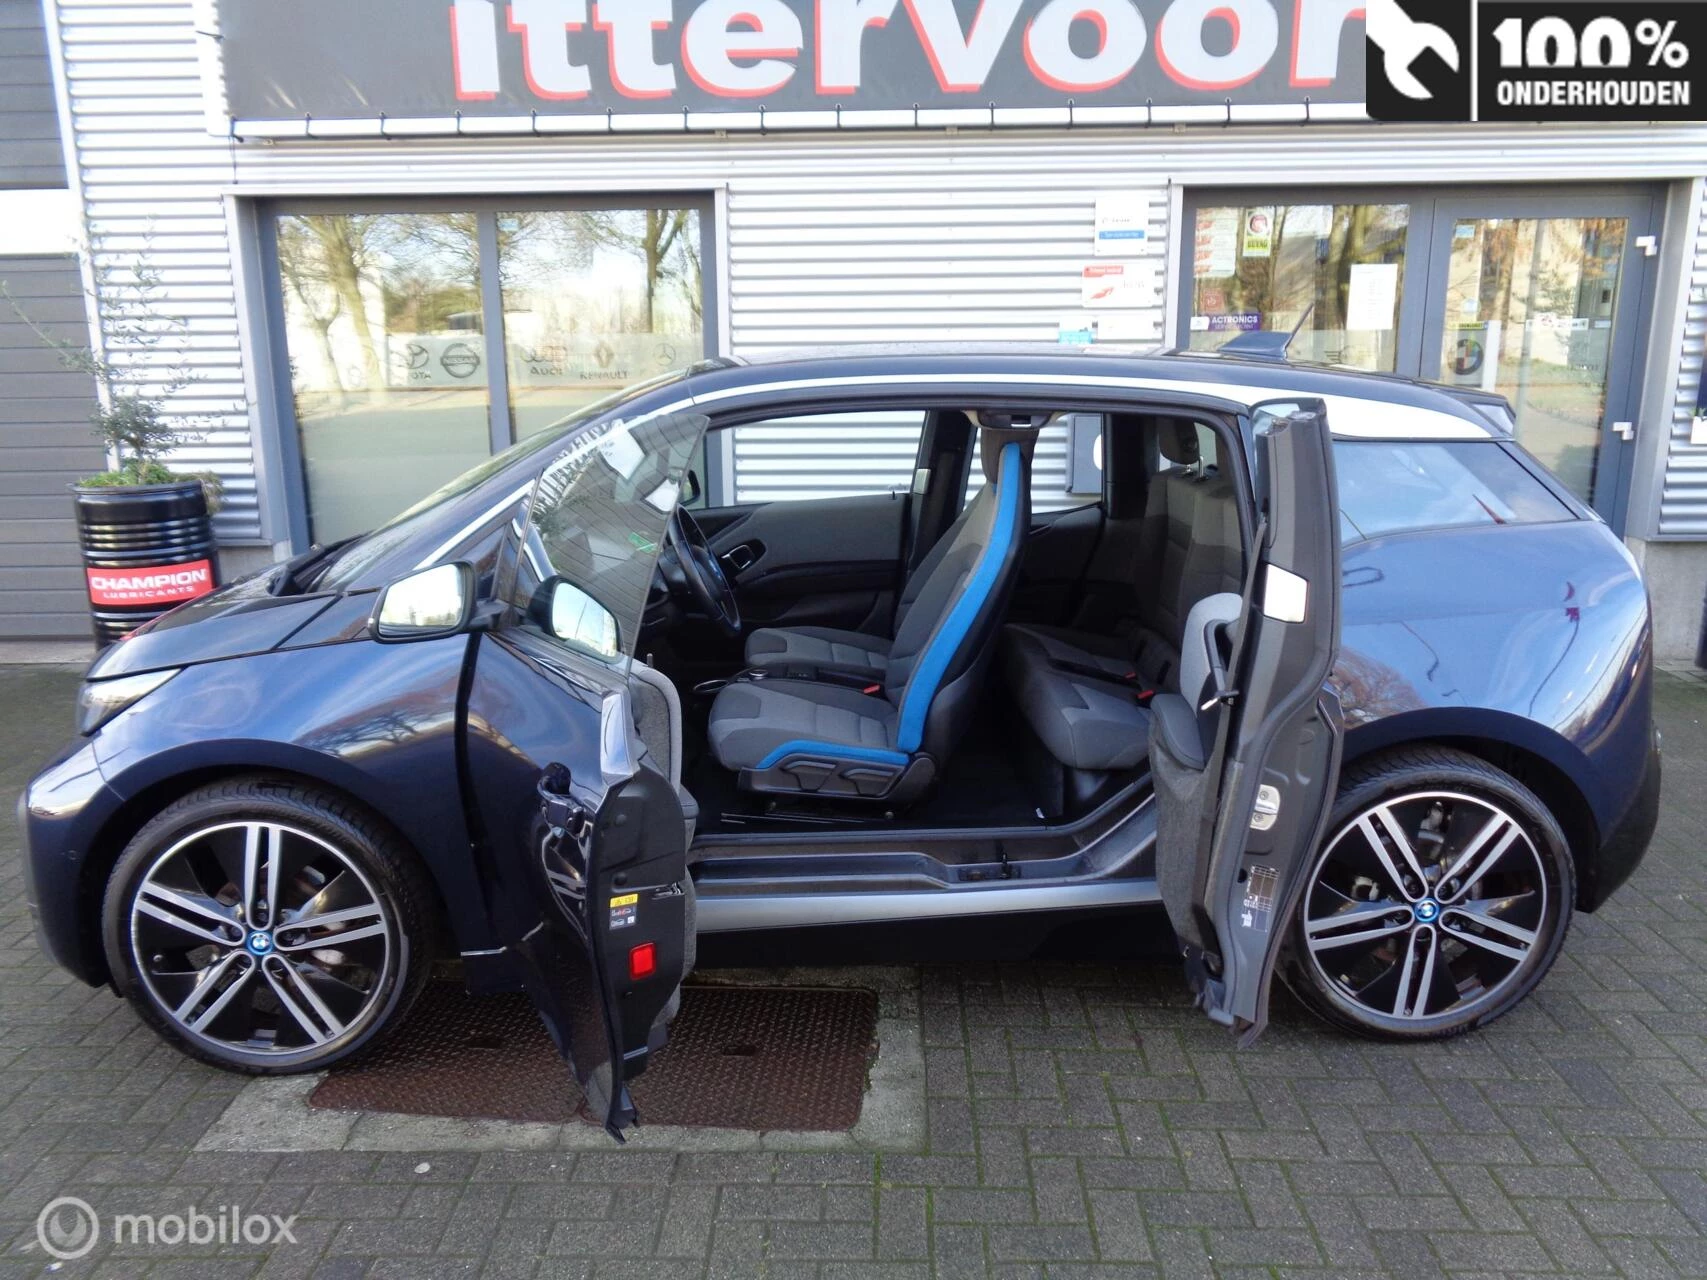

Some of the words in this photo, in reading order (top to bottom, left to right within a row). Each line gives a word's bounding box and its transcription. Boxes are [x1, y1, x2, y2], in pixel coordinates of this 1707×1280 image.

[1211, 315, 1258, 323] ACTRONICS
[91, 569, 207, 590] CHAMPION
[103, 586, 195, 599] LUBRICANTS
